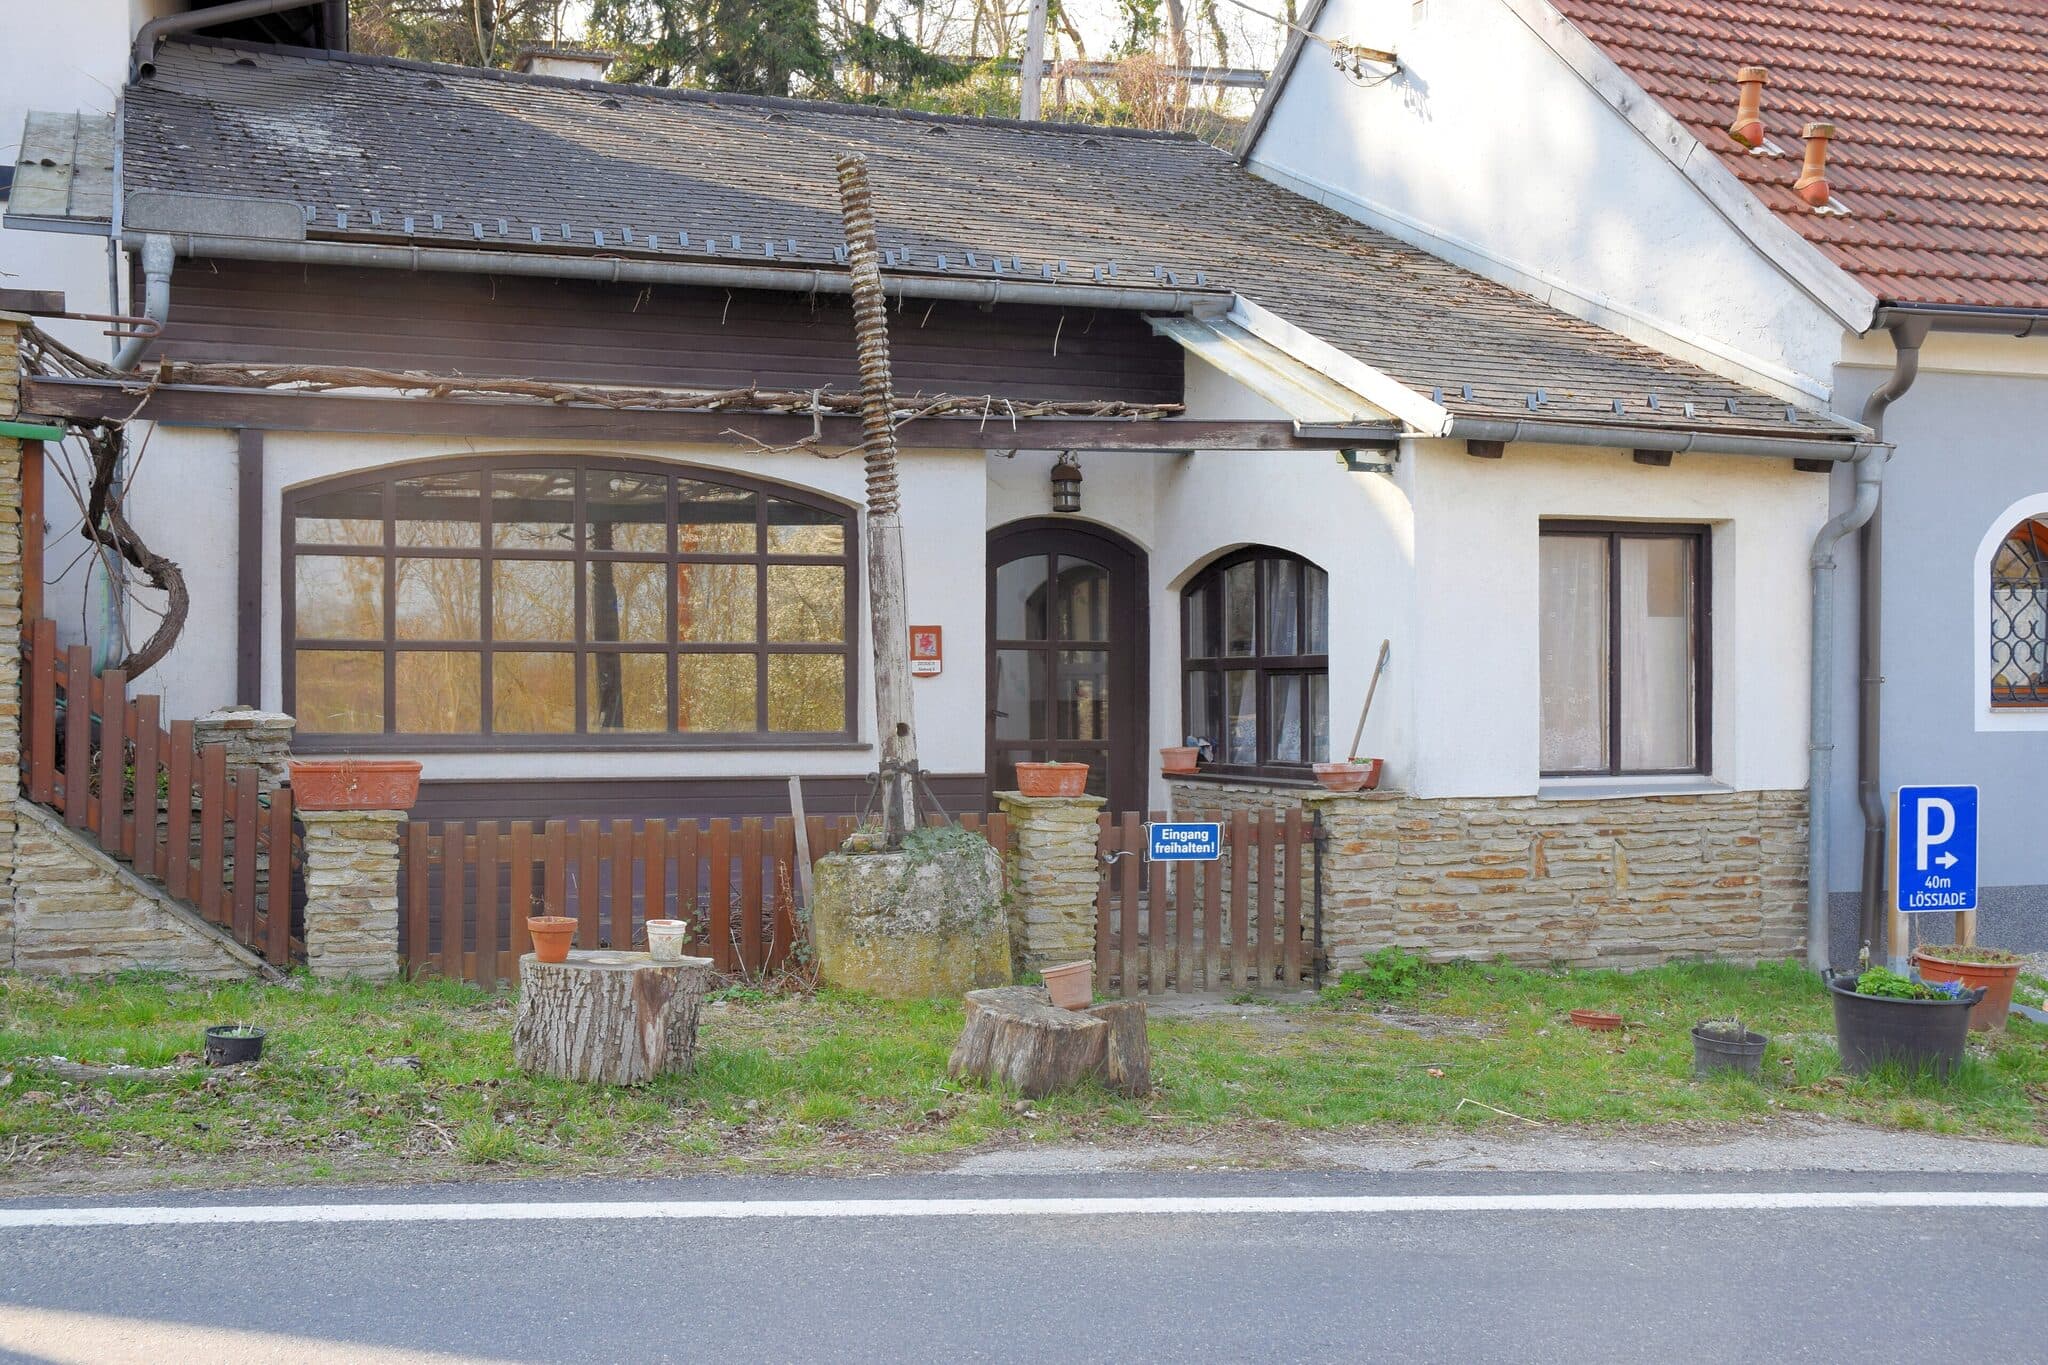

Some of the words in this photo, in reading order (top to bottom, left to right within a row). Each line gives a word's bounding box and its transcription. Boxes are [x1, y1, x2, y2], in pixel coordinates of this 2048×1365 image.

[1162, 829, 1209, 842] Eingang
[1917, 798, 1956, 870] P
[1155, 842, 1215, 853] freihalten!
[1925, 875, 1951, 889] 40m
[1909, 891, 1967, 907] LÖSSIADE
